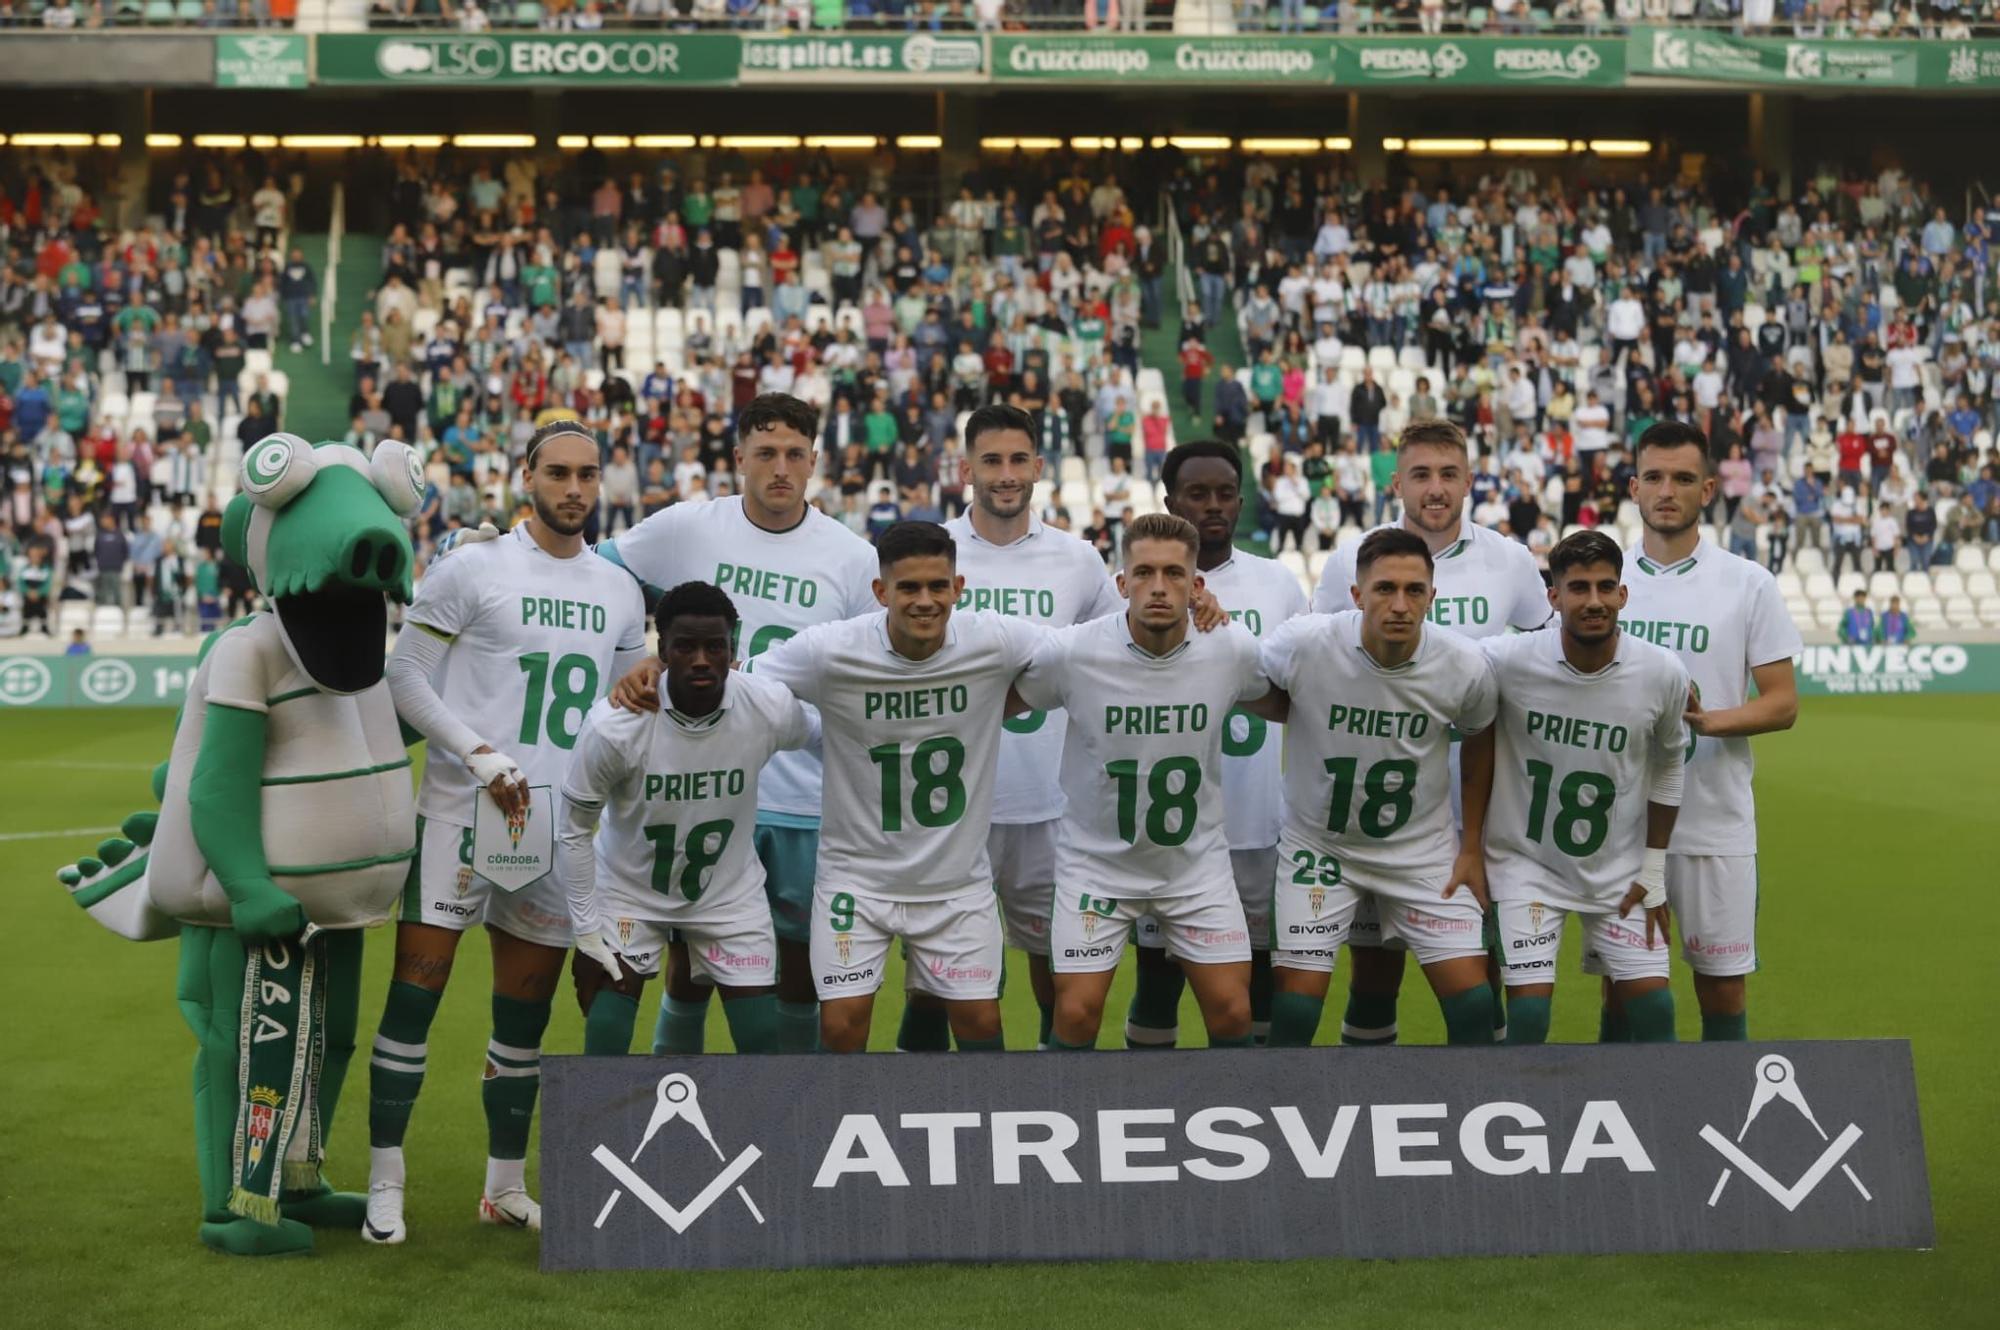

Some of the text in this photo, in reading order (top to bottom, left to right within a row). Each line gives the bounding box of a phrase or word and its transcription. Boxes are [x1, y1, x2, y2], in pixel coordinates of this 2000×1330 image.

[432, 42, 679, 74] LSC ERGOCOR
[1010, 44, 1149, 74] Cruzcampo
[1176, 43, 1313, 74] Cruzcampo
[1360, 48, 1432, 69] PIEDRA
[1494, 48, 1565, 69] PIEDRA
[714, 562, 817, 609] PRIETO
[955, 588, 1054, 618] PRIETO
[522, 597, 606, 634] PRIETO
[518, 651, 599, 750] 18
[865, 684, 968, 720] PRIETO
[1105, 703, 1208, 735] PRIETO
[1328, 703, 1429, 739] PRIETO
[1527, 710, 1628, 753] PRIETO
[645, 768, 745, 801] PRIETO
[868, 736, 968, 832] 18
[1104, 755, 1201, 847] 18
[1323, 756, 1418, 839] 18
[1525, 758, 1616, 858] 18
[643, 818, 735, 902] 18
[830, 891, 855, 932] 9
[1289, 923, 1339, 934] GIVOVA
[1064, 945, 1113, 958] GIVOVA
[1513, 932, 1557, 949] GIVOVA
[823, 969, 874, 985] GIVOVA
[812, 1099, 1657, 1189] ATRESVEGA
